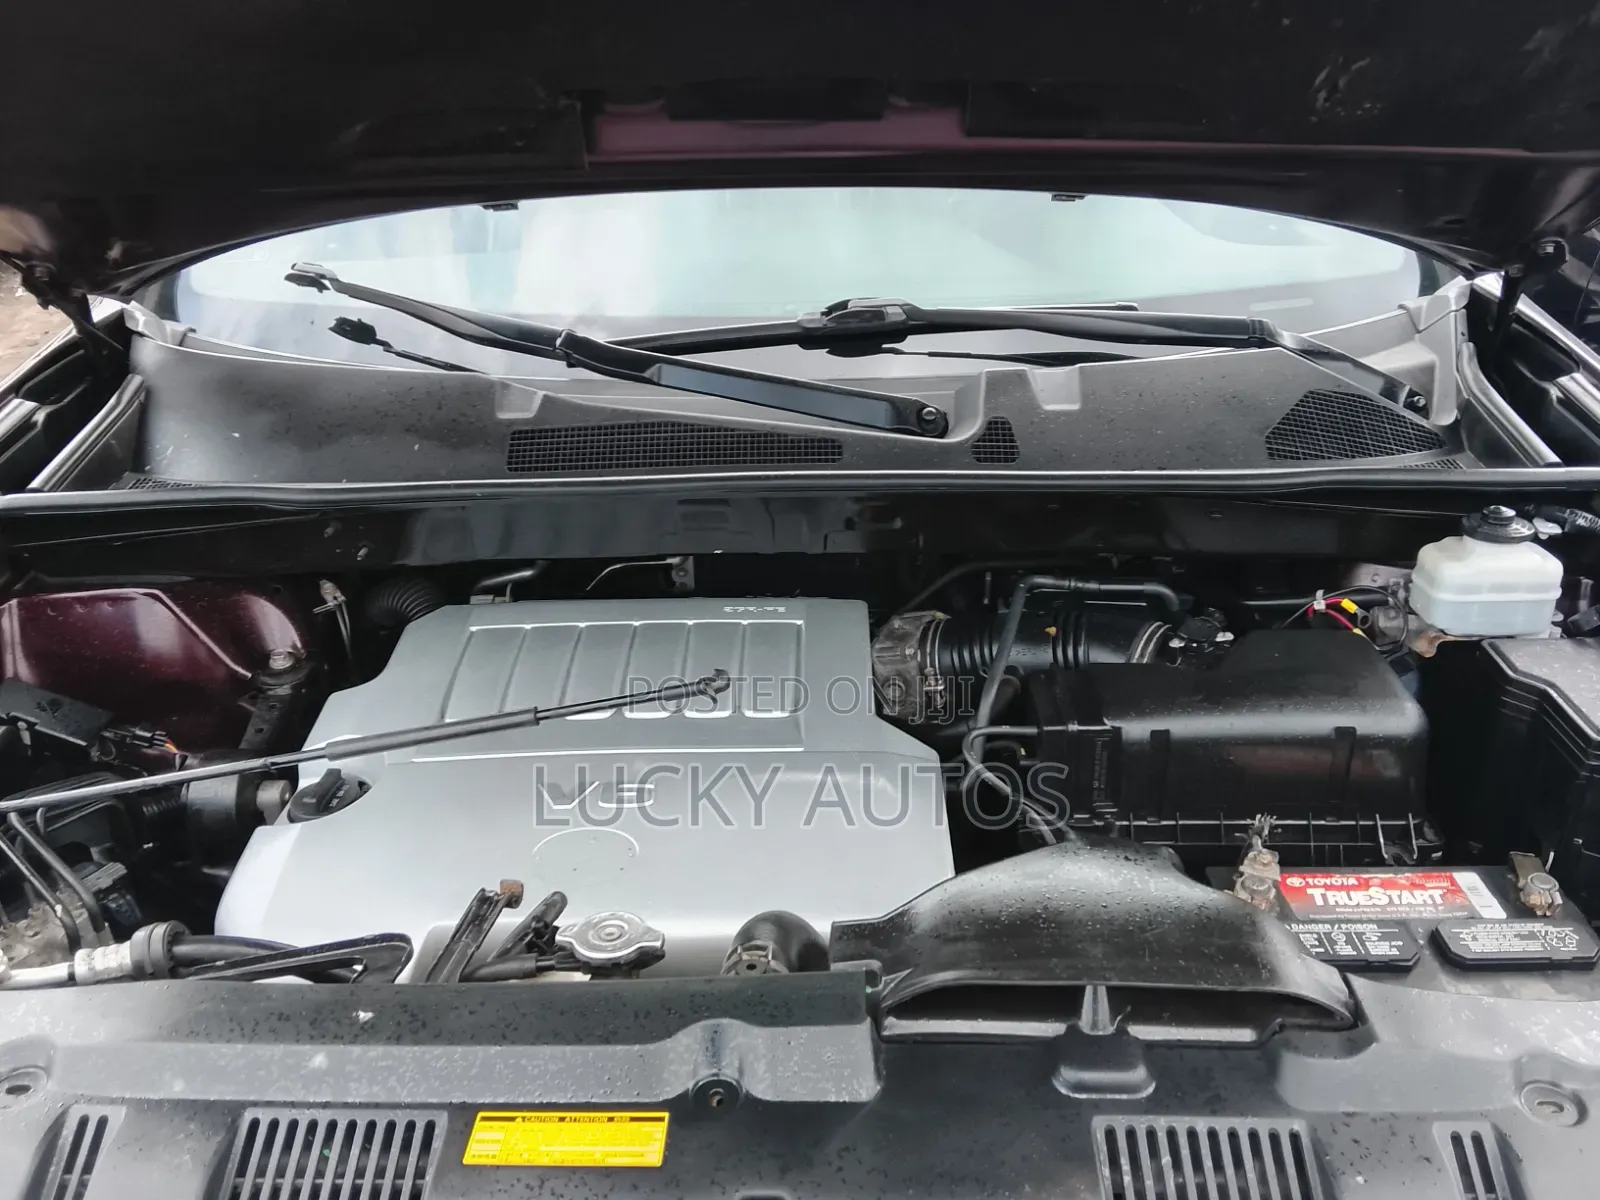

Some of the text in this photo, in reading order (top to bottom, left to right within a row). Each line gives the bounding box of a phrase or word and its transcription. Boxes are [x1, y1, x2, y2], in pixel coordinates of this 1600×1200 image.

[1306, 877, 1358, 886] TOYOTA
[1291, 923, 1332, 931] DANGER
[1341, 923, 1378, 931] POISON
